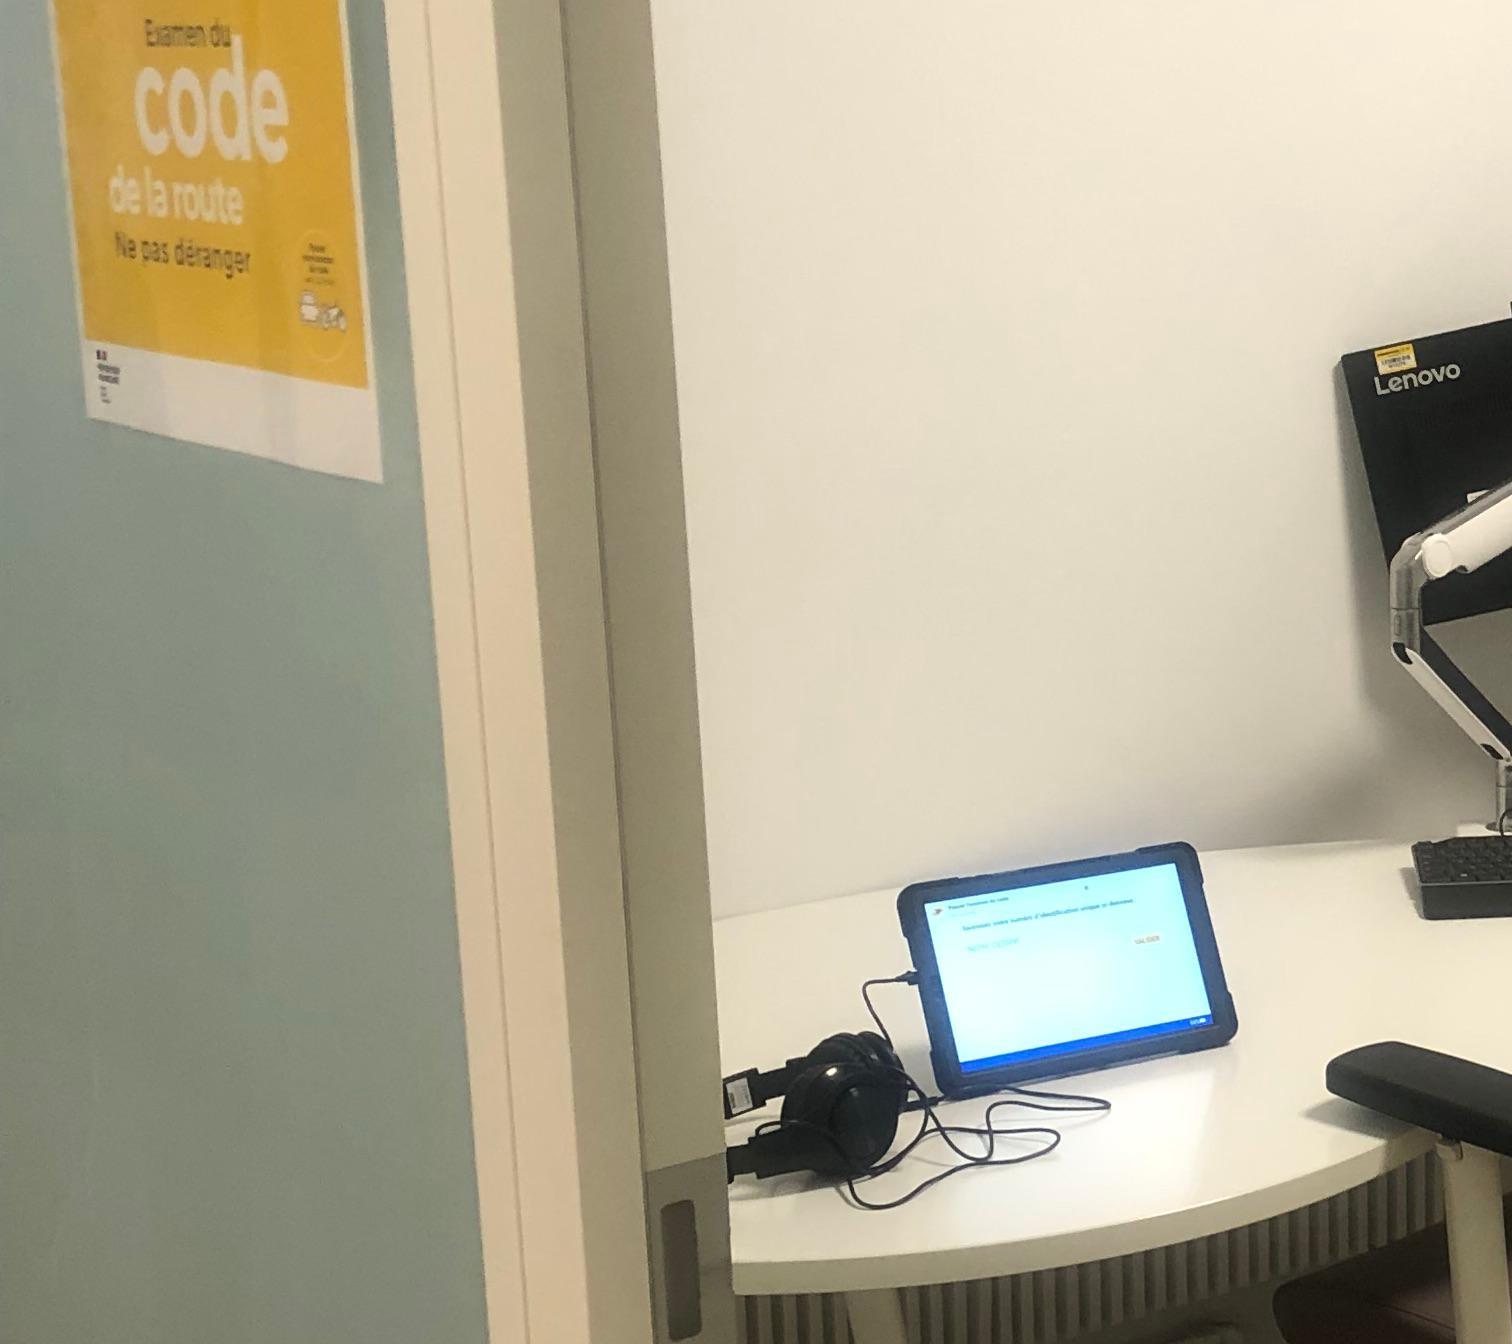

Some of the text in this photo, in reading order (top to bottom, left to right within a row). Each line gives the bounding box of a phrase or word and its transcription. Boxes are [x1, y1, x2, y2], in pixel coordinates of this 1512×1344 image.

[145, 17, 231, 48] Examen du
[135, 34, 289, 164] code
[109, 164, 244, 226] de la route
[115, 231, 251, 280] Ne pas déranger
[1373, 363, 1461, 396] Lenovo
